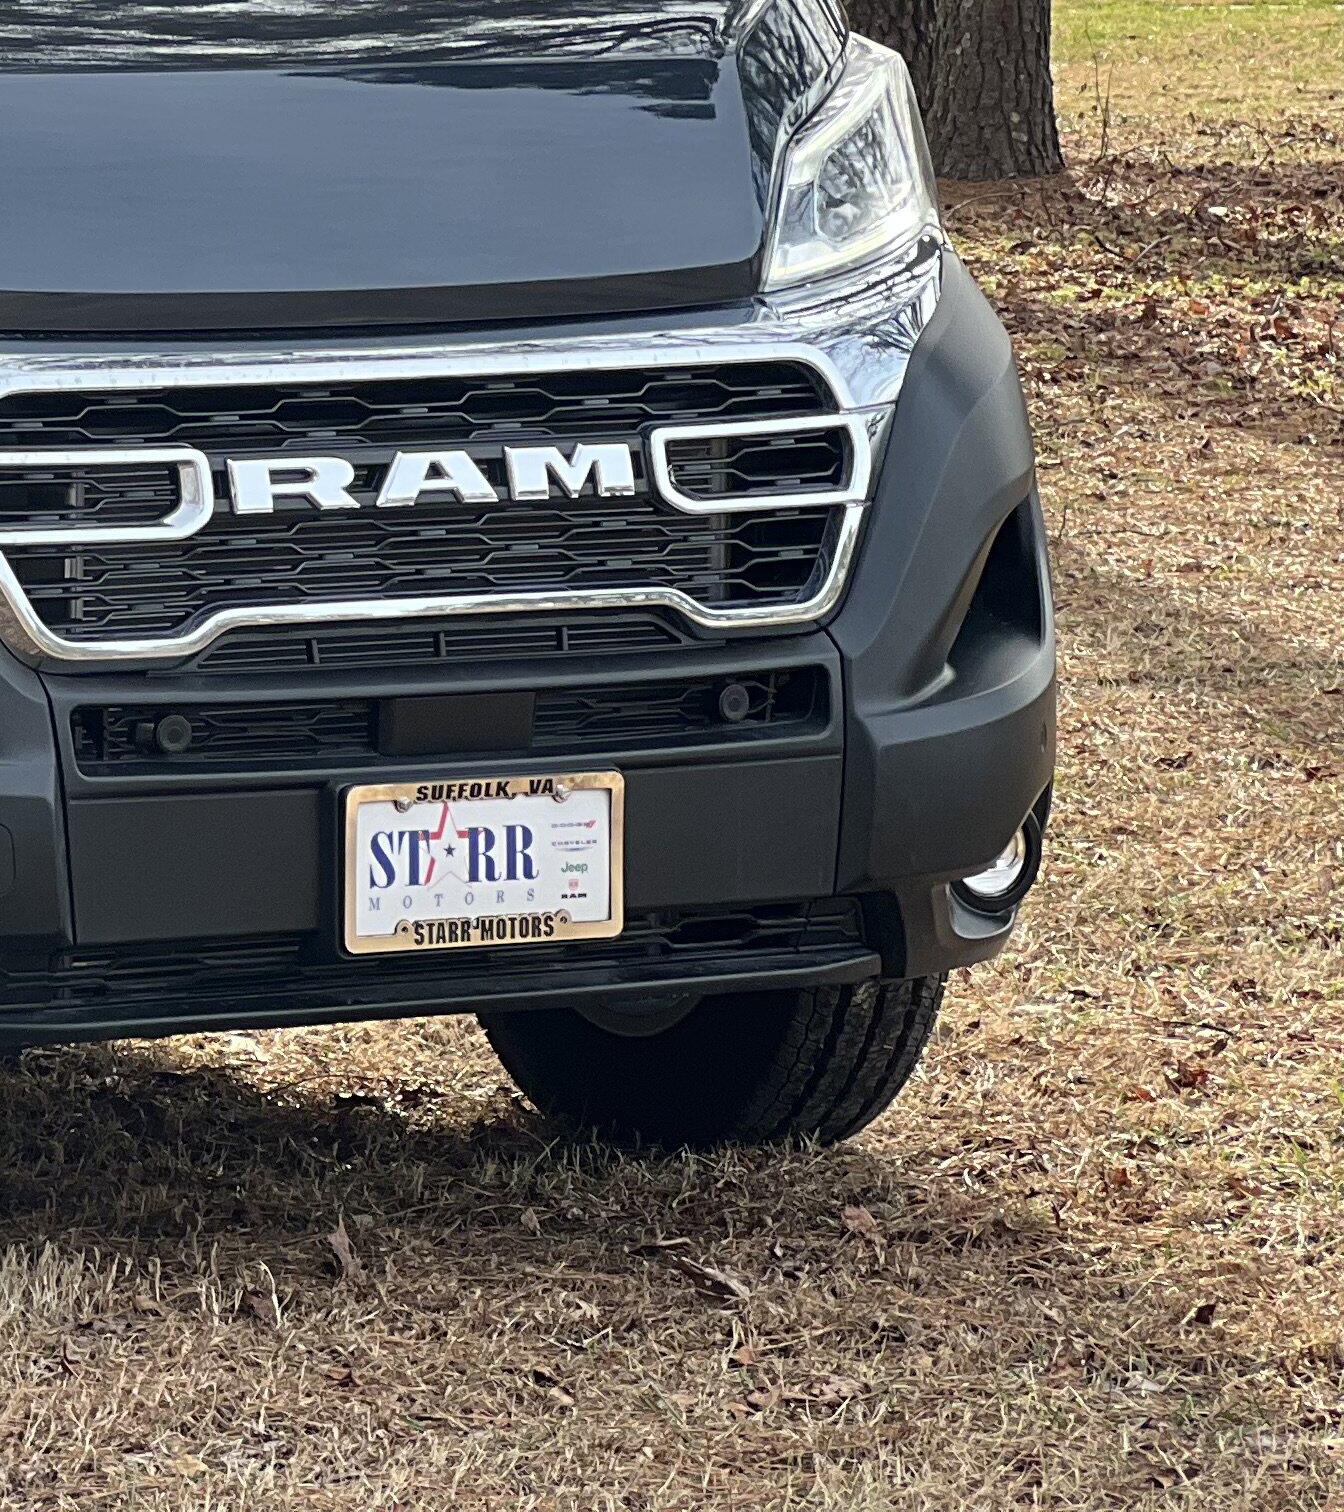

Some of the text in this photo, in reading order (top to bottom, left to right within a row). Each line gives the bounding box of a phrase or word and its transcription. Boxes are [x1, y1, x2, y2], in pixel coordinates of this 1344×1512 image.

[226, 443, 636, 515] RAM
[529, 779, 554, 794] VA
[561, 861, 589, 874] Jeep
[368, 887, 535, 911] MOTORS
[414, 915, 555, 945] STARR MOTORS
